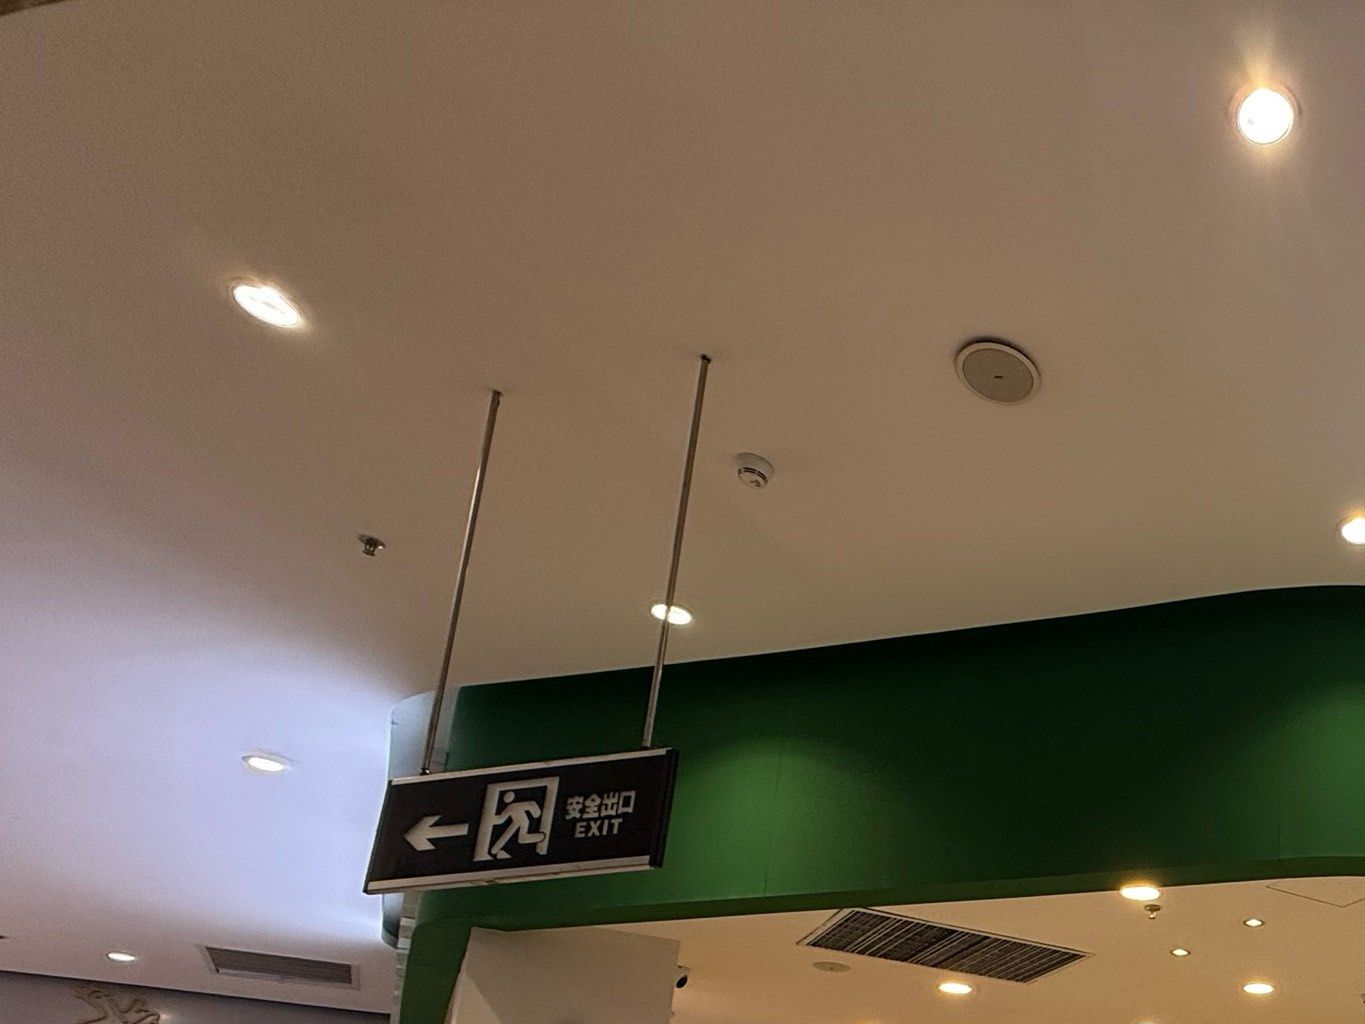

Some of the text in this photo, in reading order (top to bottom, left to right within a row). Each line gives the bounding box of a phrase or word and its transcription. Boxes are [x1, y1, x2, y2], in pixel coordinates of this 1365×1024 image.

[566, 790, 636, 820] 安全出口
[574, 817, 623, 838] EXIT
